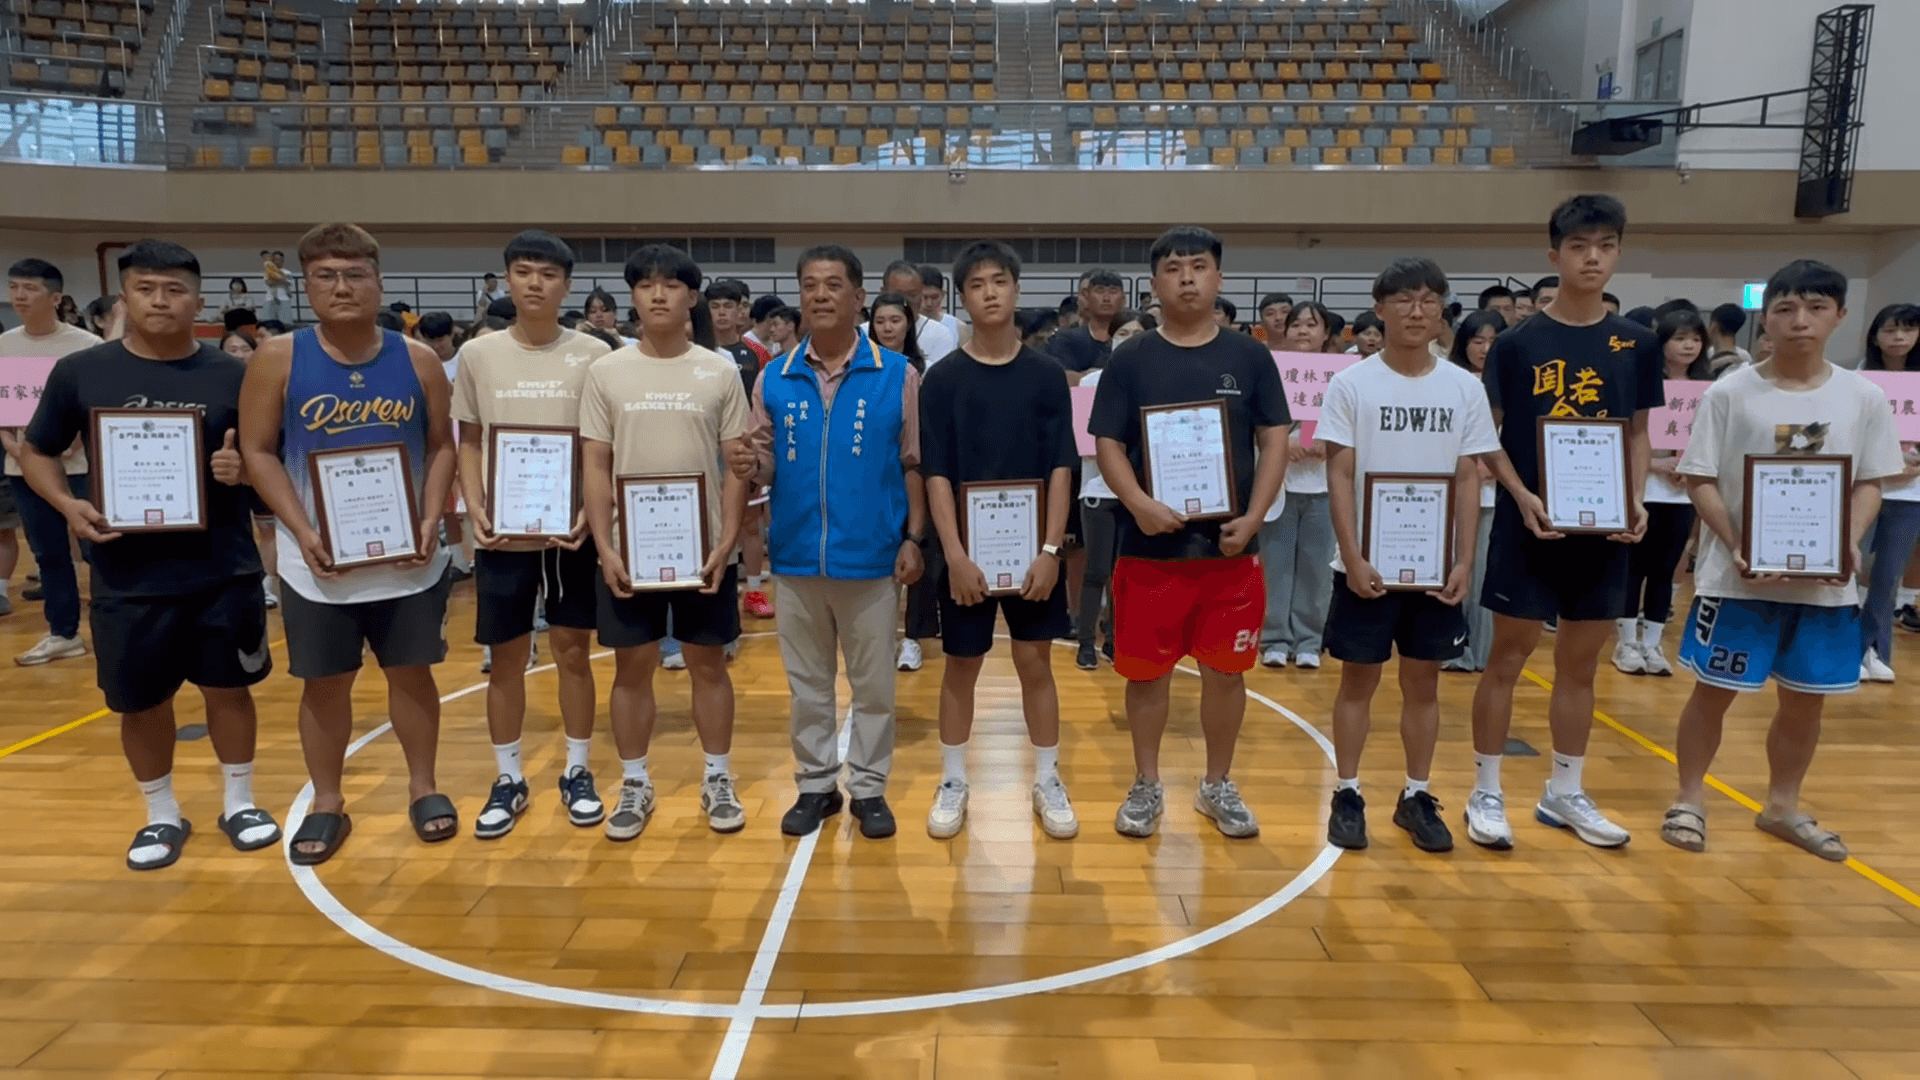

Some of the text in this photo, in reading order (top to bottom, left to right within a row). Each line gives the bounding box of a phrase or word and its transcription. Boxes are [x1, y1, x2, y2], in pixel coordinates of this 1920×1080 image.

[496, 389, 578, 400] BASKETBALL
[624, 401, 706, 413] BASKETBALL
[300, 394, 415, 431] Dscrew
[1379, 406, 1454, 432] EDWIN
[1233, 628, 1260, 652] 24
[1707, 646, 1749, 675] 26
